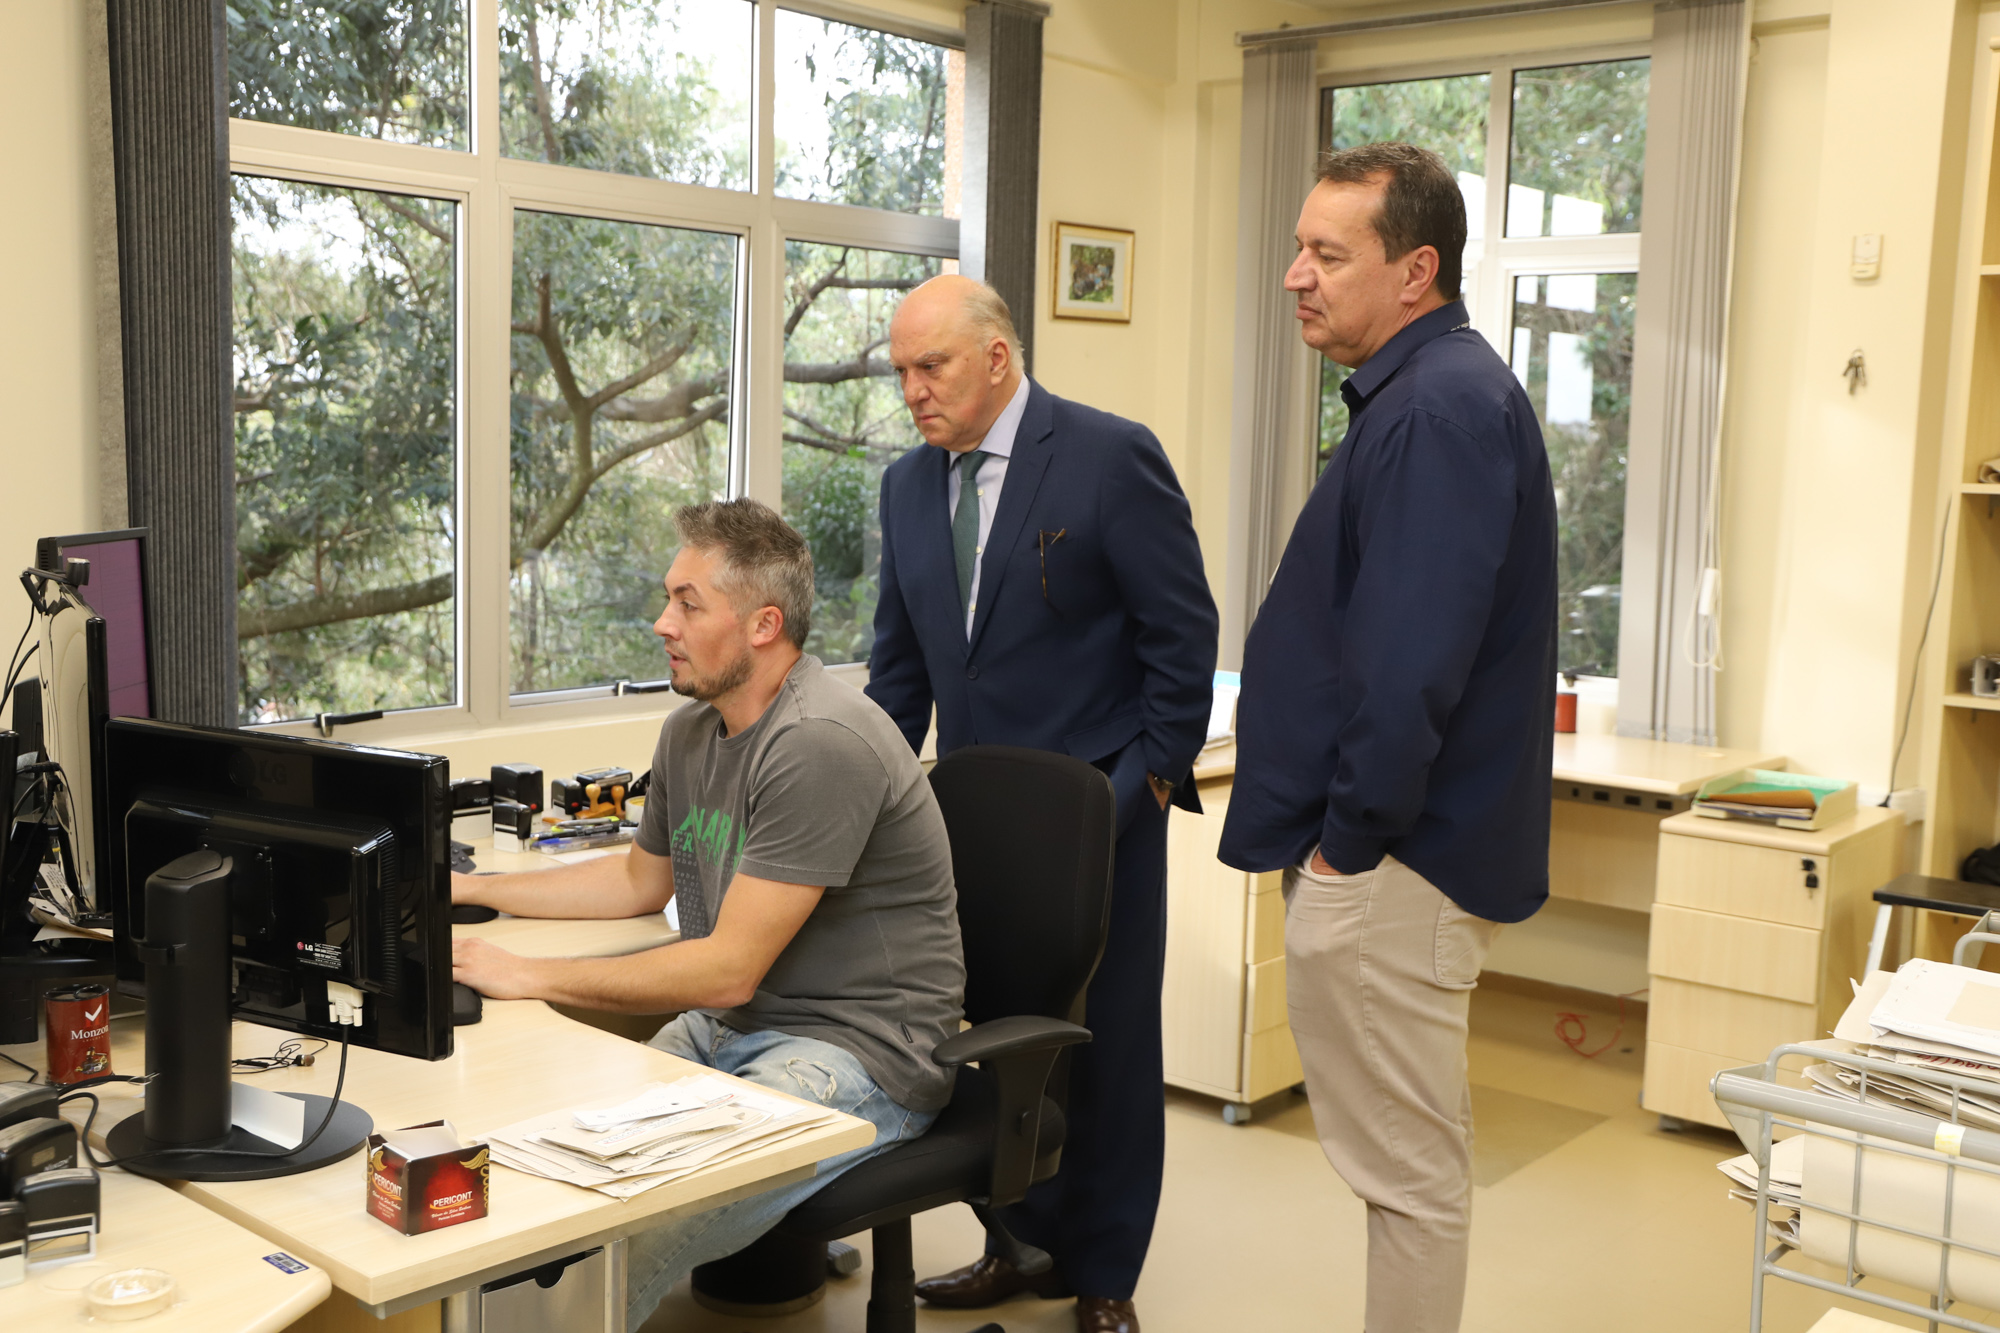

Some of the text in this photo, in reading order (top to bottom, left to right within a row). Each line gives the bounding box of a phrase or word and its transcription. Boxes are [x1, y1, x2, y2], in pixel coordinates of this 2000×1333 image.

[259, 759, 288, 786] LG
[304, 943, 314, 952] LG
[374, 1172, 403, 1197] PERICONT
[433, 1190, 473, 1208] PERICONT
